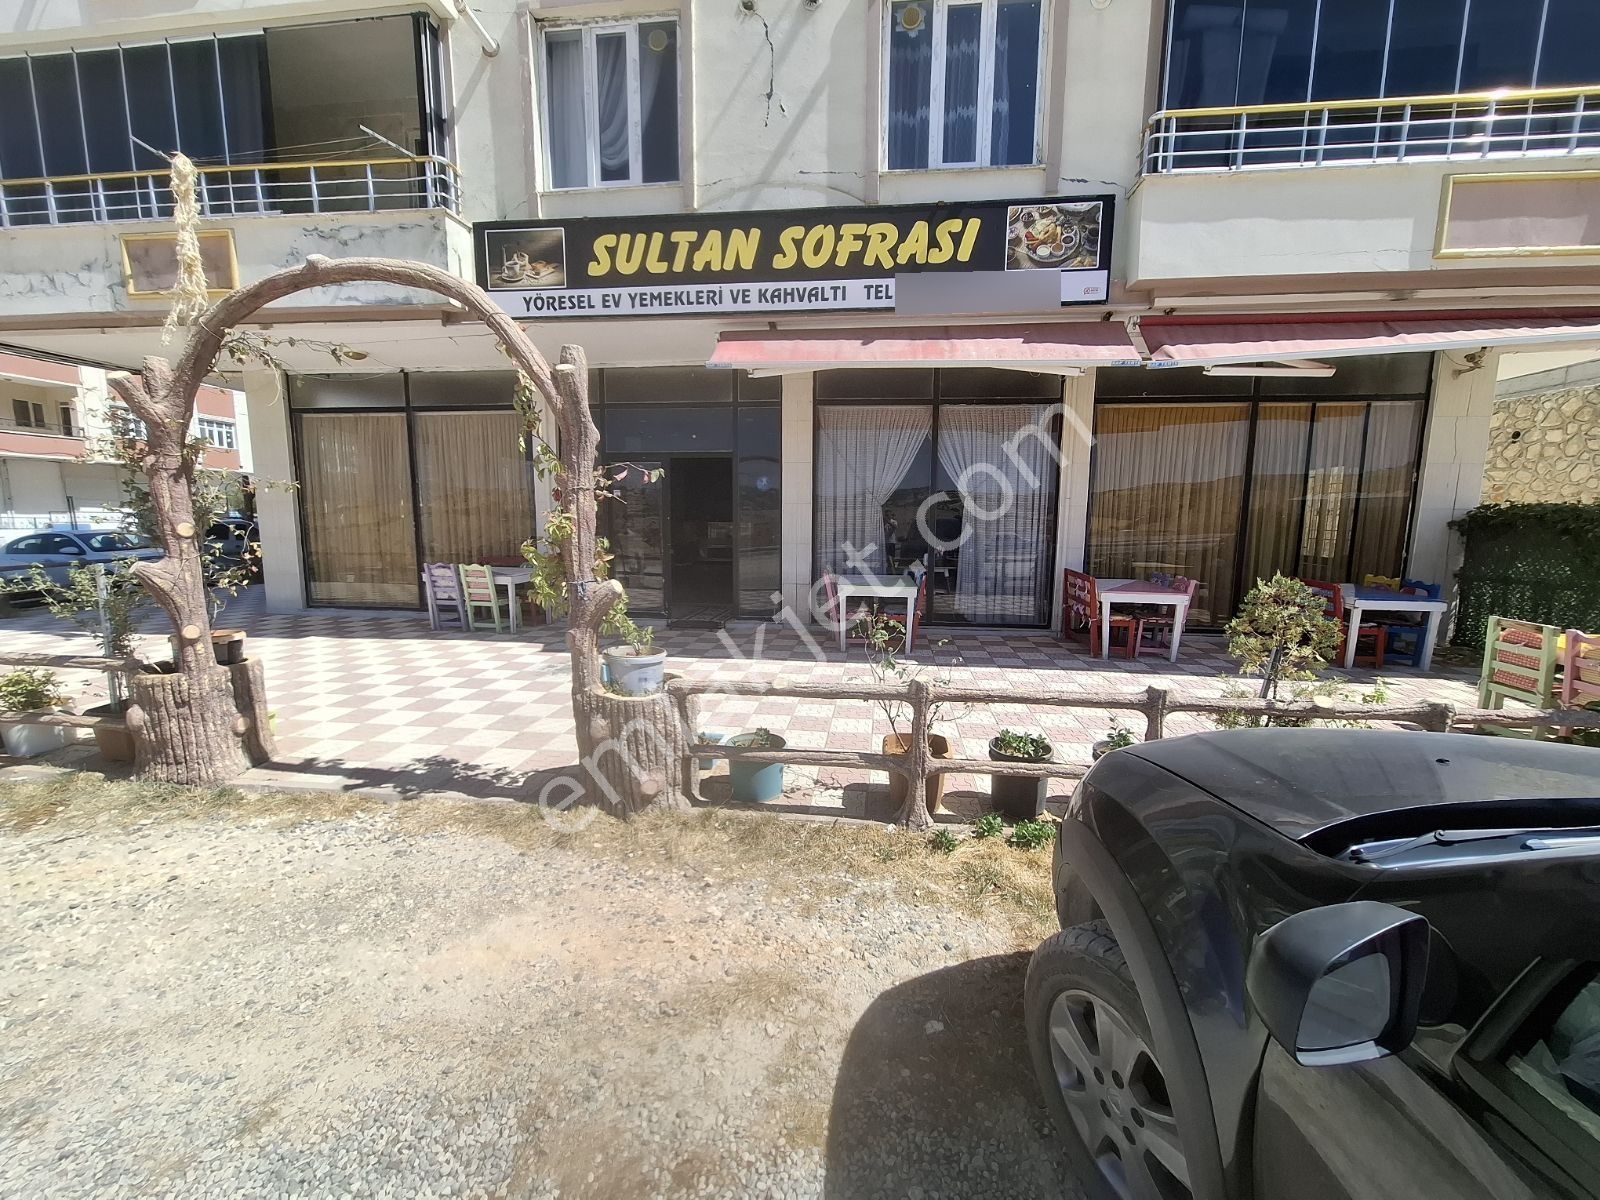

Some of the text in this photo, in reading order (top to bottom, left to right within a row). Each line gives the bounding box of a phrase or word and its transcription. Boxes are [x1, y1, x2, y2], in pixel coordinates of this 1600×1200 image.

[587, 217, 981, 277] SULTAN SOFRASI
[522, 283, 893, 313] YÖRESEL EV YEMEKLERİ VE KAHVALTI TEL
